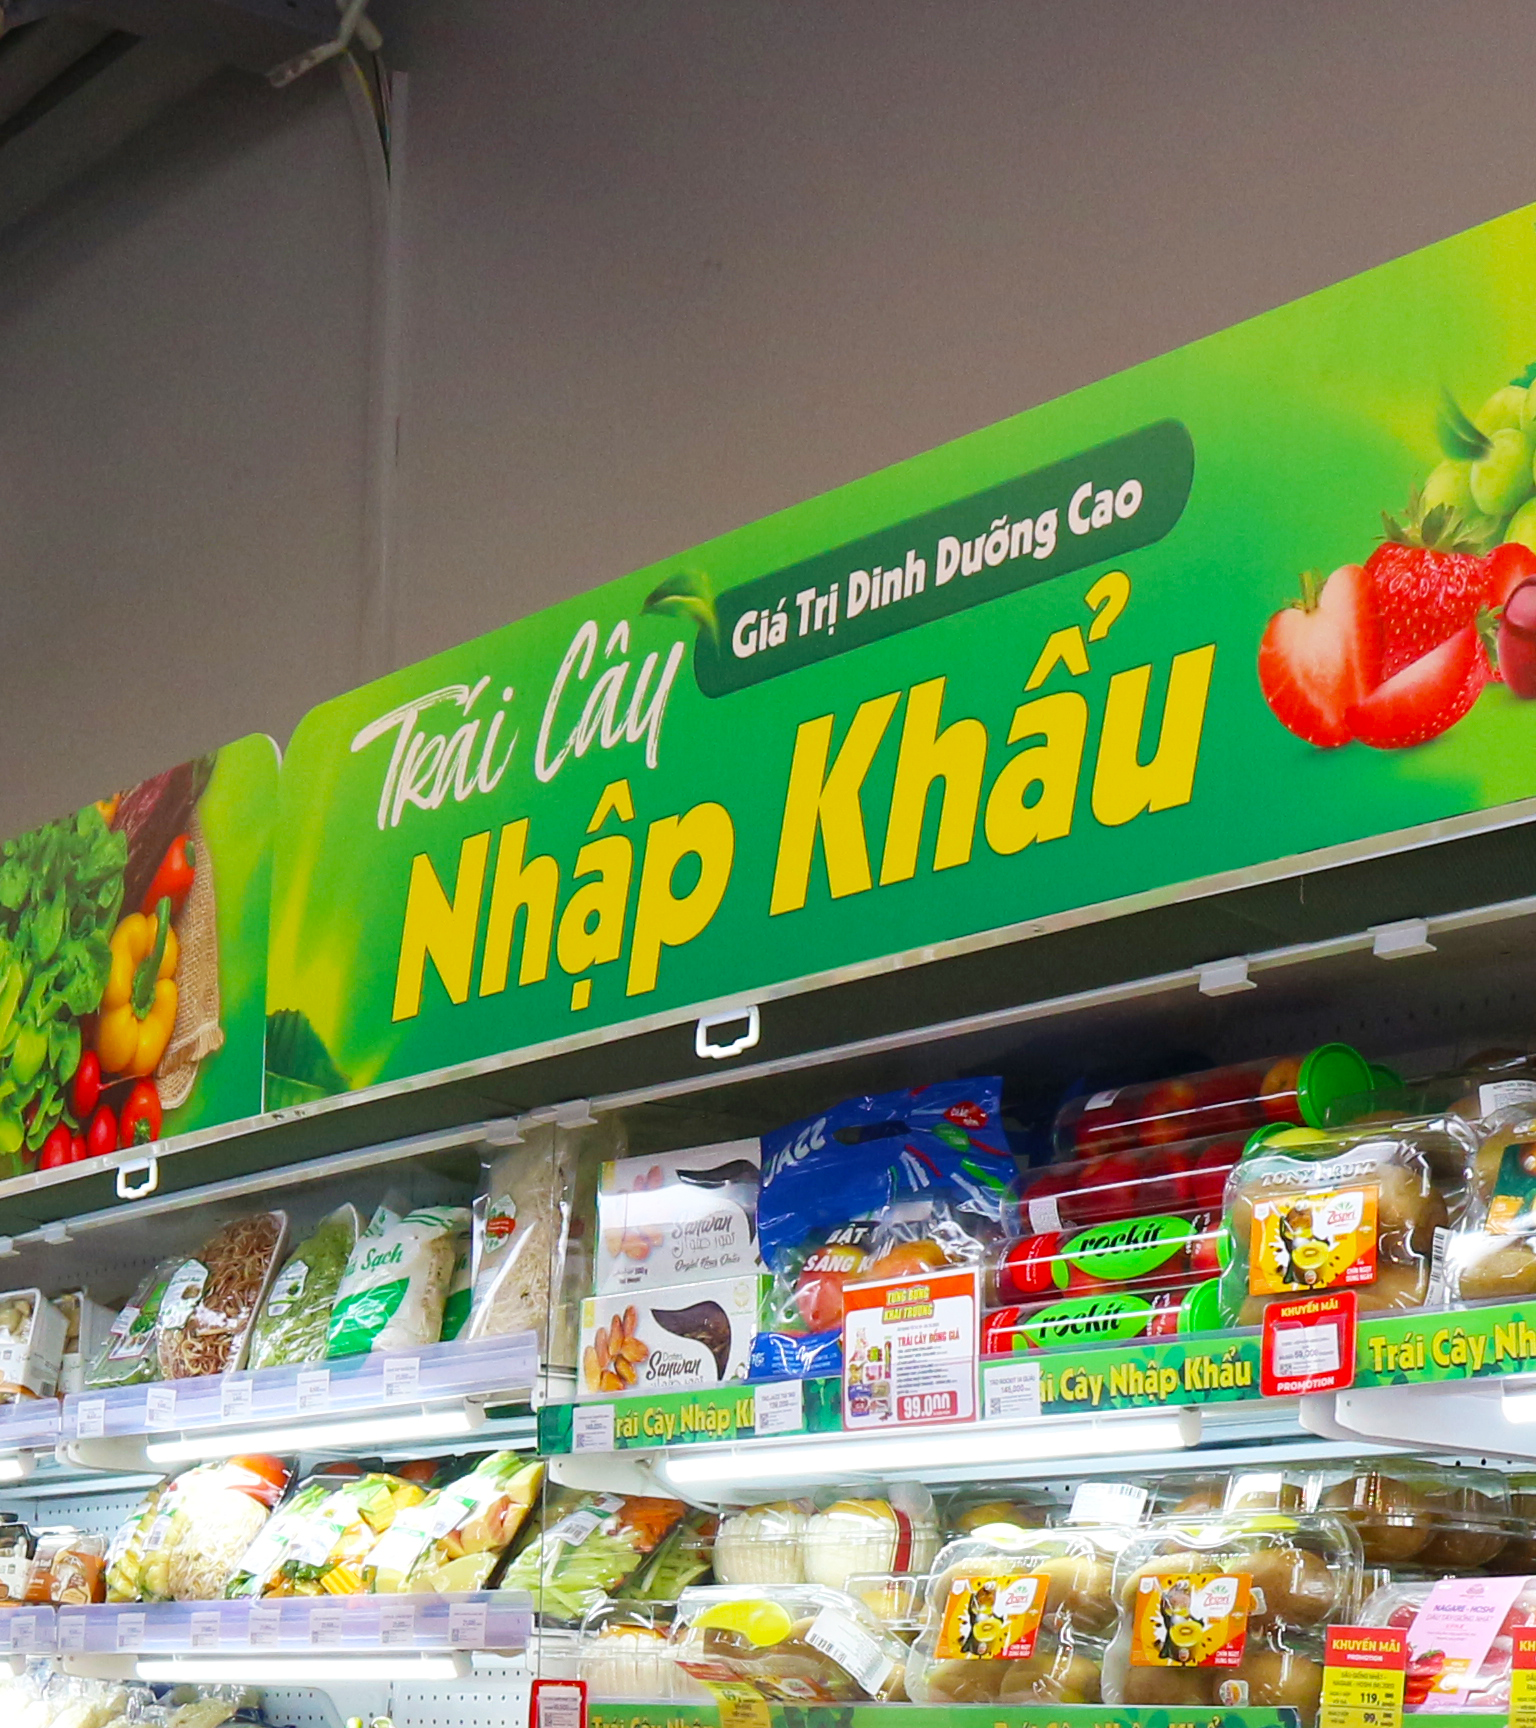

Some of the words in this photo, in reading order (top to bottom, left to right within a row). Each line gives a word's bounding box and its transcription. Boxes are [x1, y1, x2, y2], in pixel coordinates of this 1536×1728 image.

[731, 594, 787, 659] Giá
[796, 582, 839, 636] Trị
[847, 551, 925, 618] Dinh
[934, 499, 1059, 581] Dưỡng
[1066, 478, 1143, 537] Cao
[350, 676, 519, 829] Trái
[534, 620, 685, 782] Cây
[390, 778, 735, 1024] Nhập
[768, 569, 1216, 917] Khẩu
[764, 1117, 827, 1188] JAZZ
[1327, 1211, 1355, 1224] Zespri
[361, 1242, 404, 1275] Sạch
[1078, 1223, 1166, 1259] rockit
[1038, 1300, 1126, 1340] rockit
[1280, 1301, 1318, 1318] KHUYẾN
[1320, 1299, 1339, 1312] MÃI
[646, 1350, 702, 1380] Sanwan
[1368, 1333, 1425, 1373] Trái
[1432, 1325, 1488, 1371] Cây
[1277, 1375, 1335, 1392] PROMOTION
[1332, 1637, 1377, 1652] KHUYẾN
[1379, 1639, 1401, 1653] MÃI
